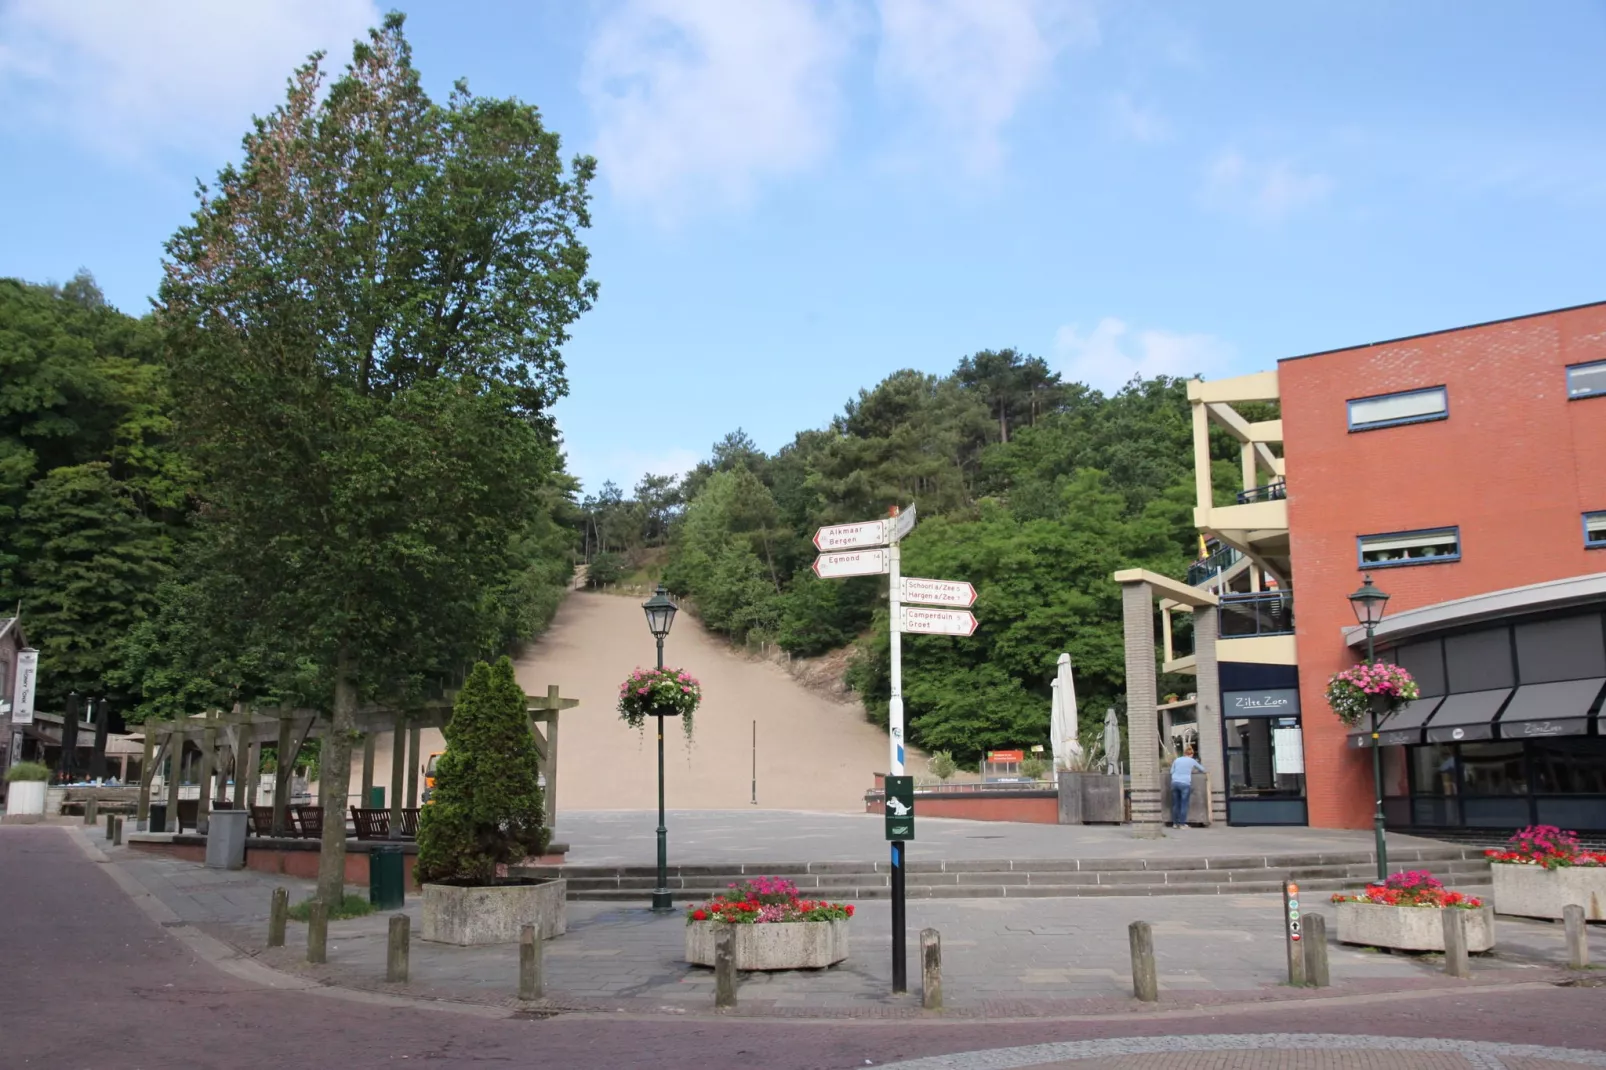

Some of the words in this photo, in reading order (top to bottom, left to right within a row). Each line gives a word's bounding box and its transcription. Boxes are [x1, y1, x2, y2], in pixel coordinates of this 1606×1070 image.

[829, 527, 863, 536] Alkmaar
[829, 537, 857, 545] Bergen
[828, 555, 860, 564] Egmond
[908, 581, 934, 590] Schoorl
[908, 591, 933, 600] Hargen
[934, 593, 955, 601] a/Zee
[908, 611, 953, 620] Camperduin
[908, 620, 931, 628] Groet
[1235, 696, 1261, 707] Zilte
[1263, 696, 1288, 706] Zoen
